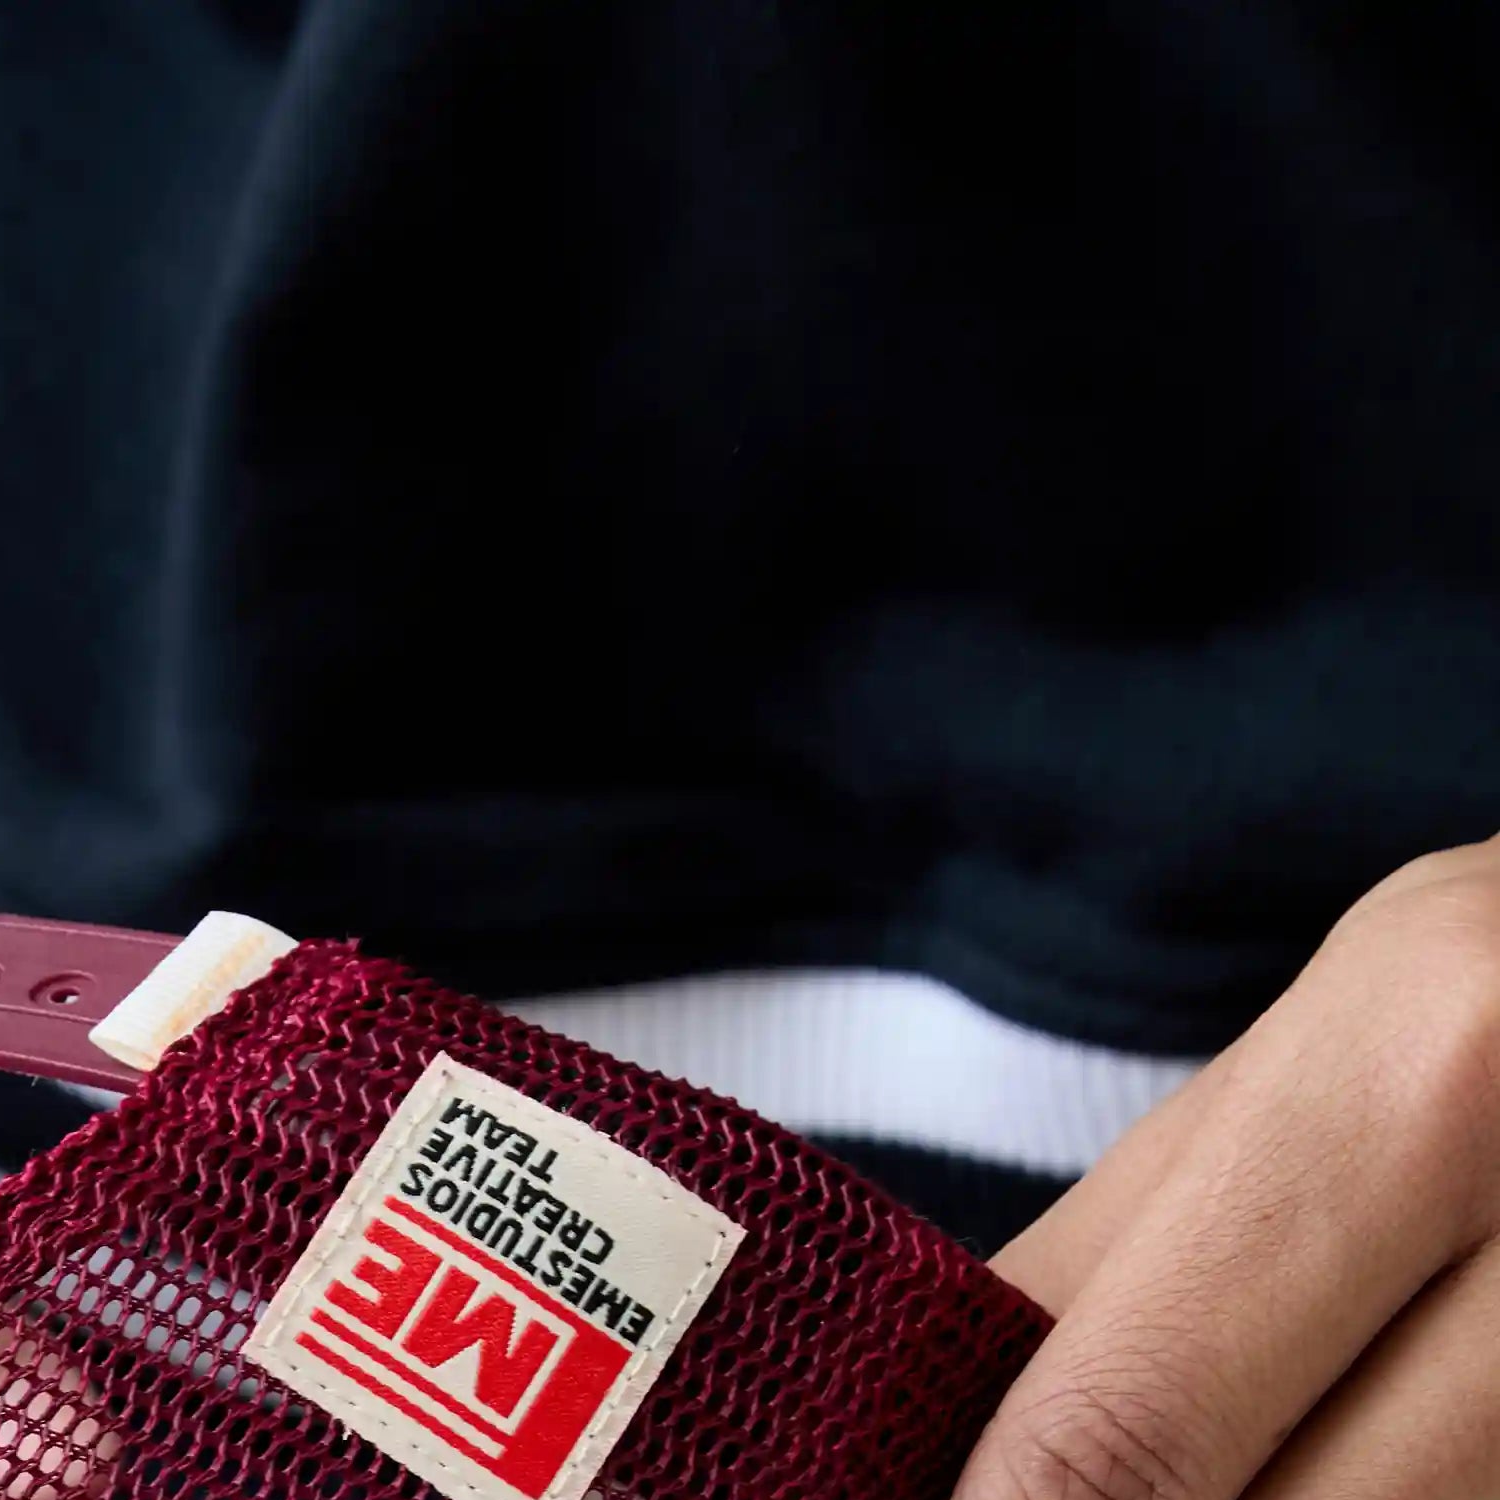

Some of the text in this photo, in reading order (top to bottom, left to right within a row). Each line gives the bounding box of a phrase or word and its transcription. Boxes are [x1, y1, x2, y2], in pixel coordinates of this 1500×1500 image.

[419, 1128, 614, 1265] CREATIVE
[440, 1097, 559, 1181] TEAM
[400, 1163, 655, 1346] EMESTUDIOS
